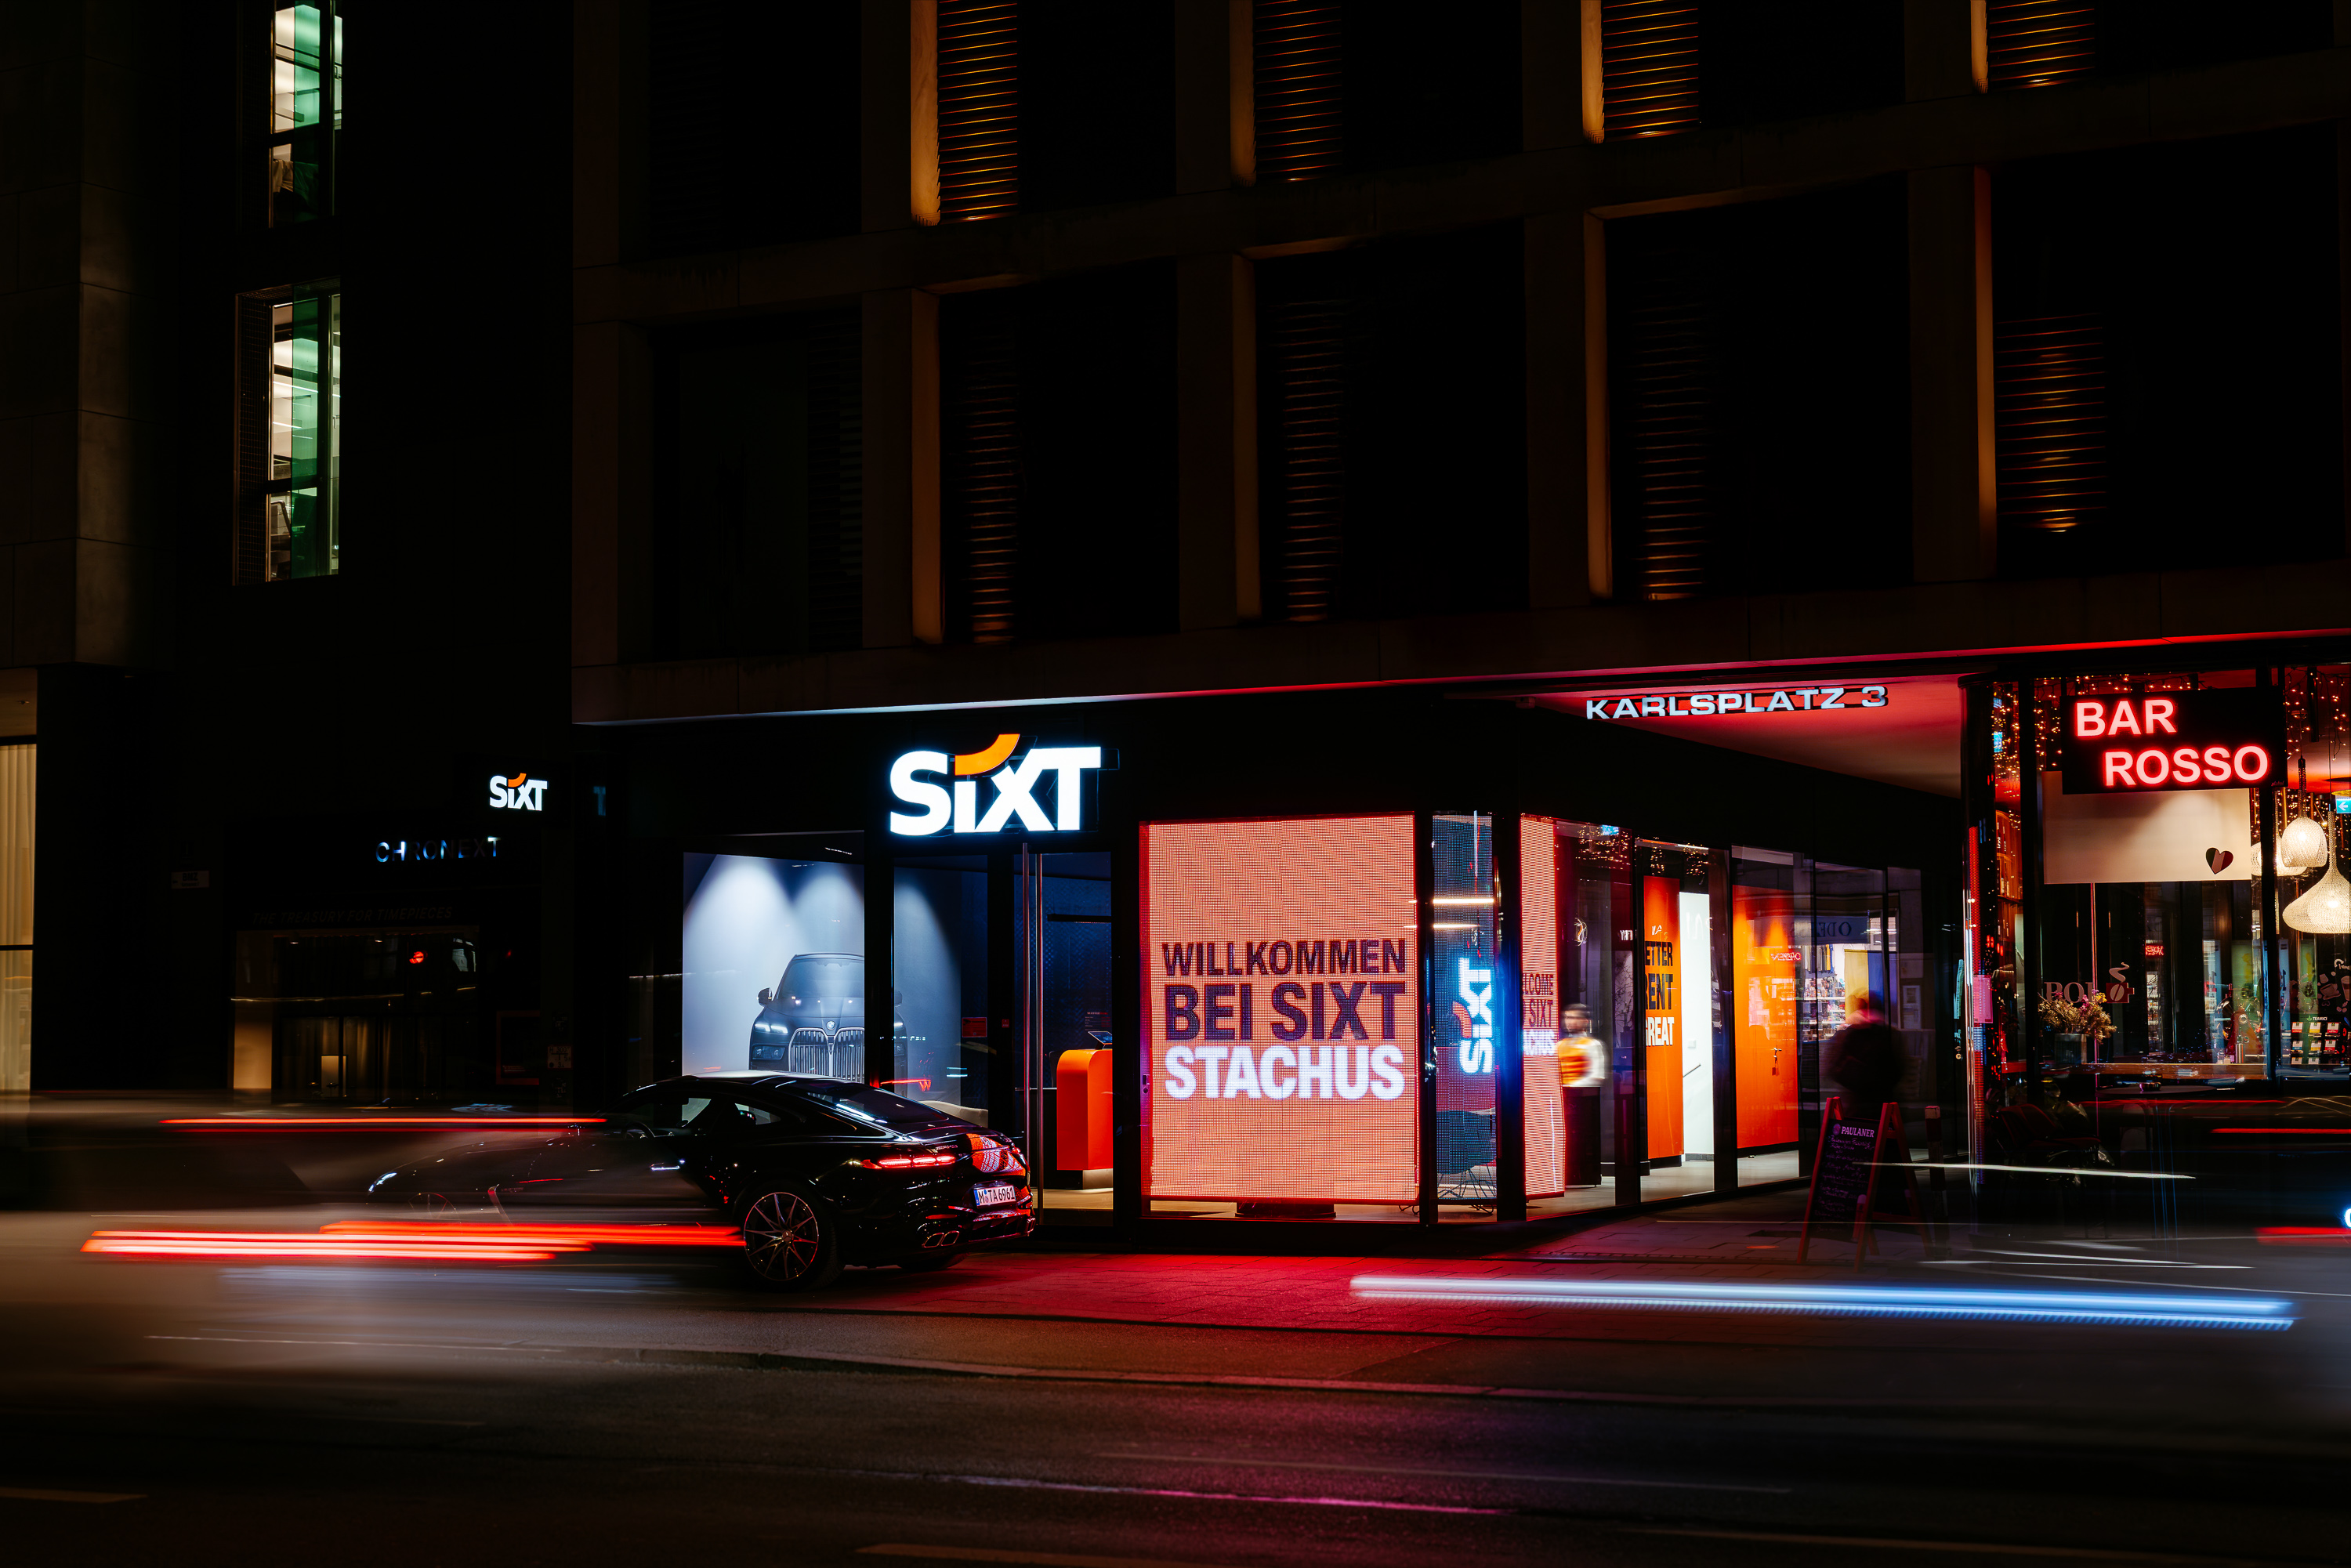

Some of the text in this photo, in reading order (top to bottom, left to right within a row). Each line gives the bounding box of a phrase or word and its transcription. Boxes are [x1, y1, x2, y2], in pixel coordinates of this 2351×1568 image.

[1586, 686, 1886, 719] KARLSPLATZ 3
[2075, 698, 2177, 737] BAR
[2104, 745, 2269, 787] ROSSO
[375, 835, 502, 863] CHRONEXT
[252, 906, 453, 925] THE TREASURY FOR TIMEPIECES
[1162, 939, 1405, 976] WILLKOMMEN
[1523, 972, 1554, 995] LCOME
[1165, 981, 1406, 1041] BEI SIXT
[1165, 1045, 1405, 1100] STACHUS
[1841, 1126, 1875, 1138] PAULANER
